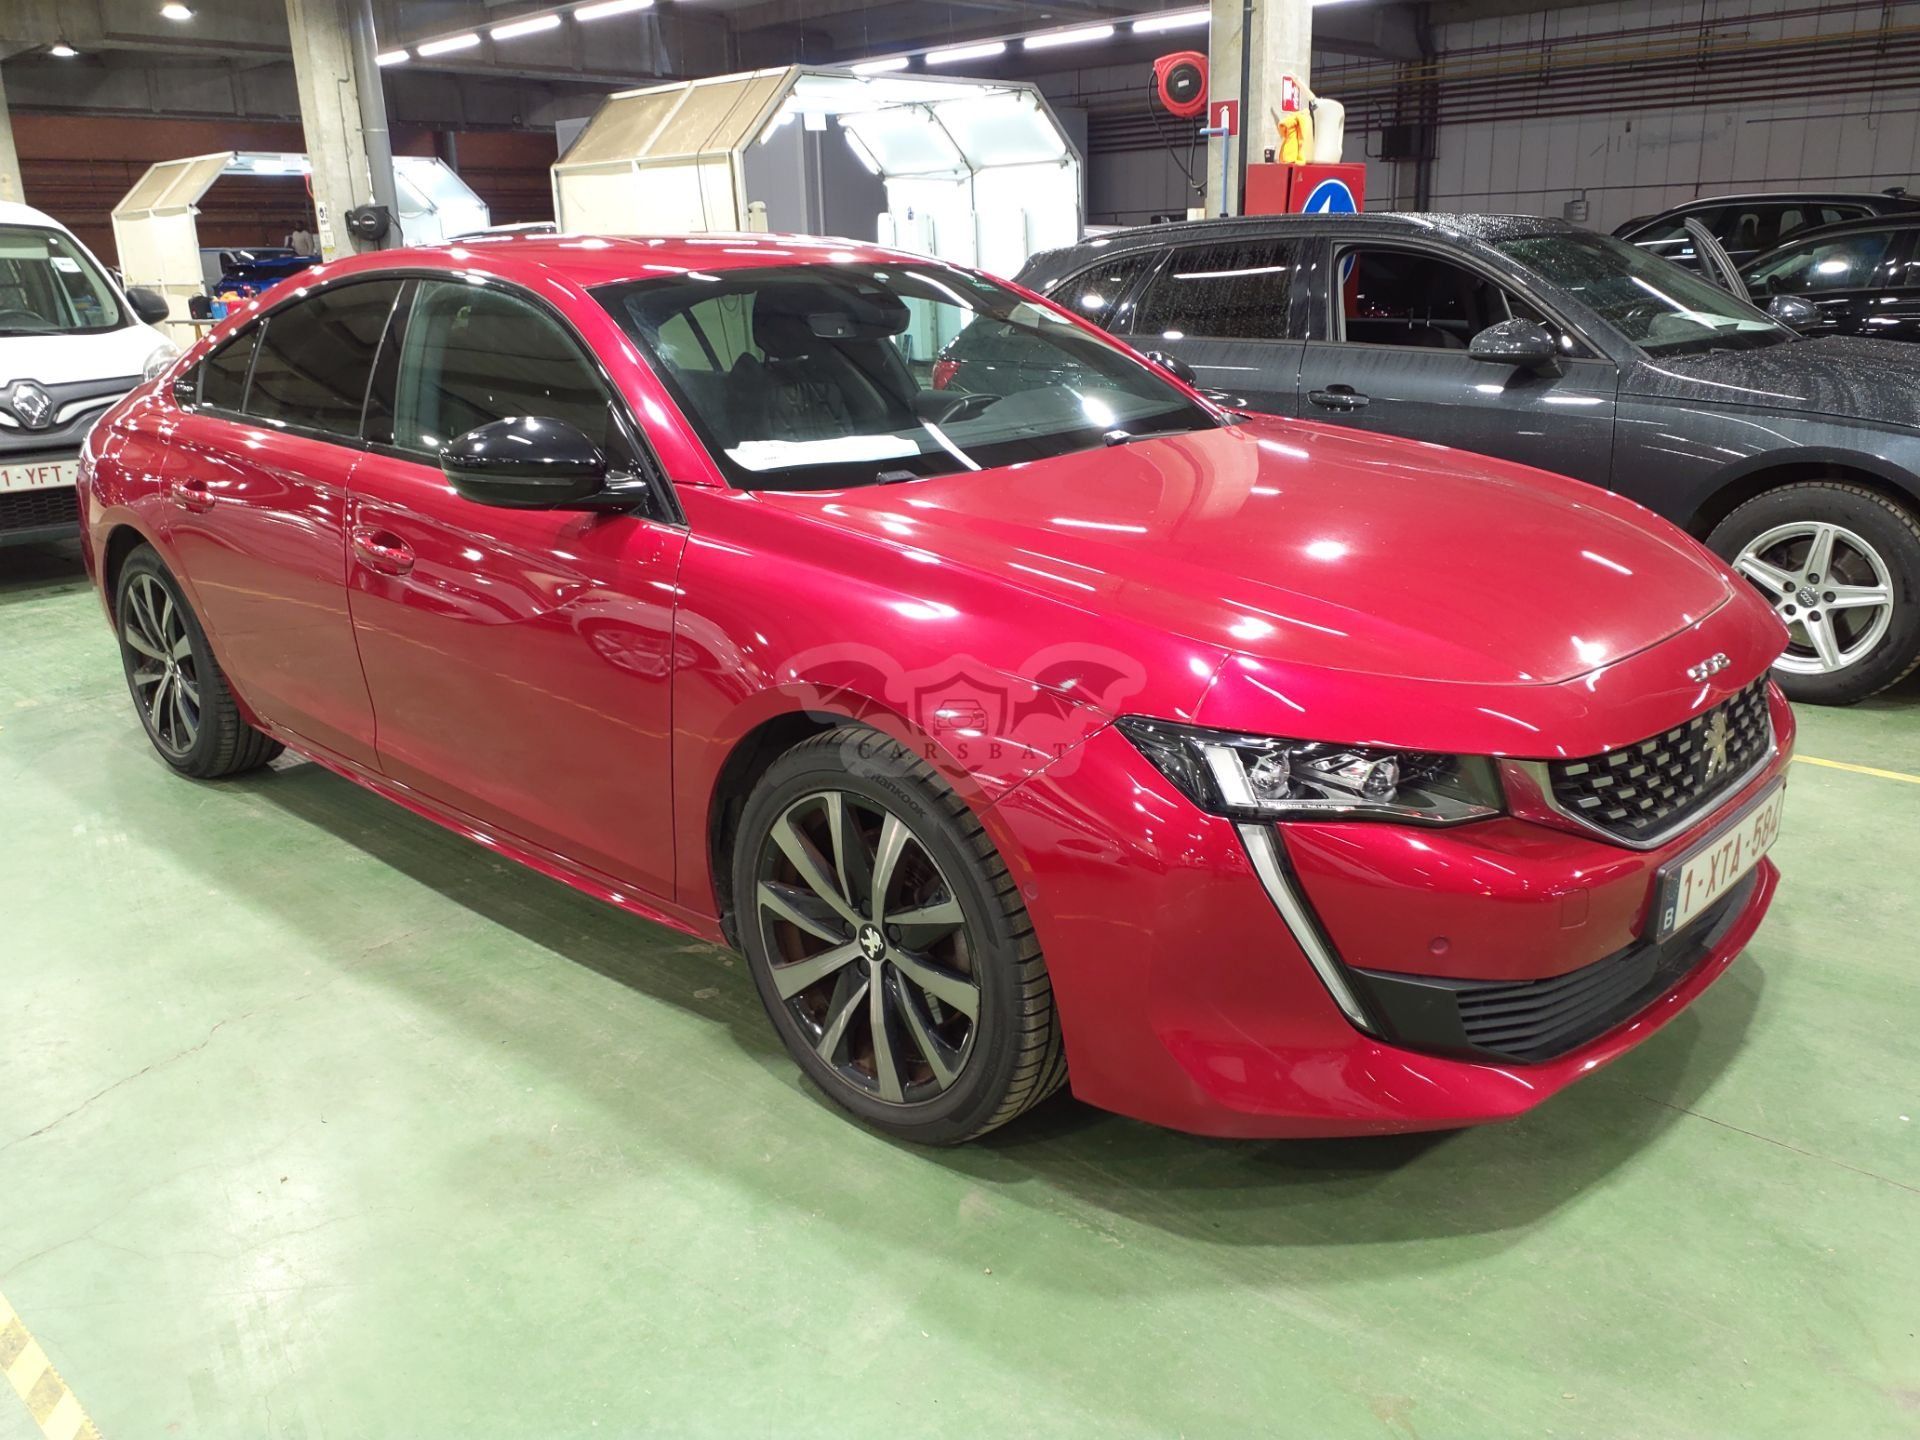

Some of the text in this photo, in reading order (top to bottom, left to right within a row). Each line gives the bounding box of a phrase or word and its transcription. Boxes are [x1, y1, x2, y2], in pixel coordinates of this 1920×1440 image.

[1, 463, 80, 487] 1-YFT-
[1686, 652, 1731, 683] 508
[1683, 793, 1782, 914] 1-XTA-584
[1663, 906, 1675, 931] B
